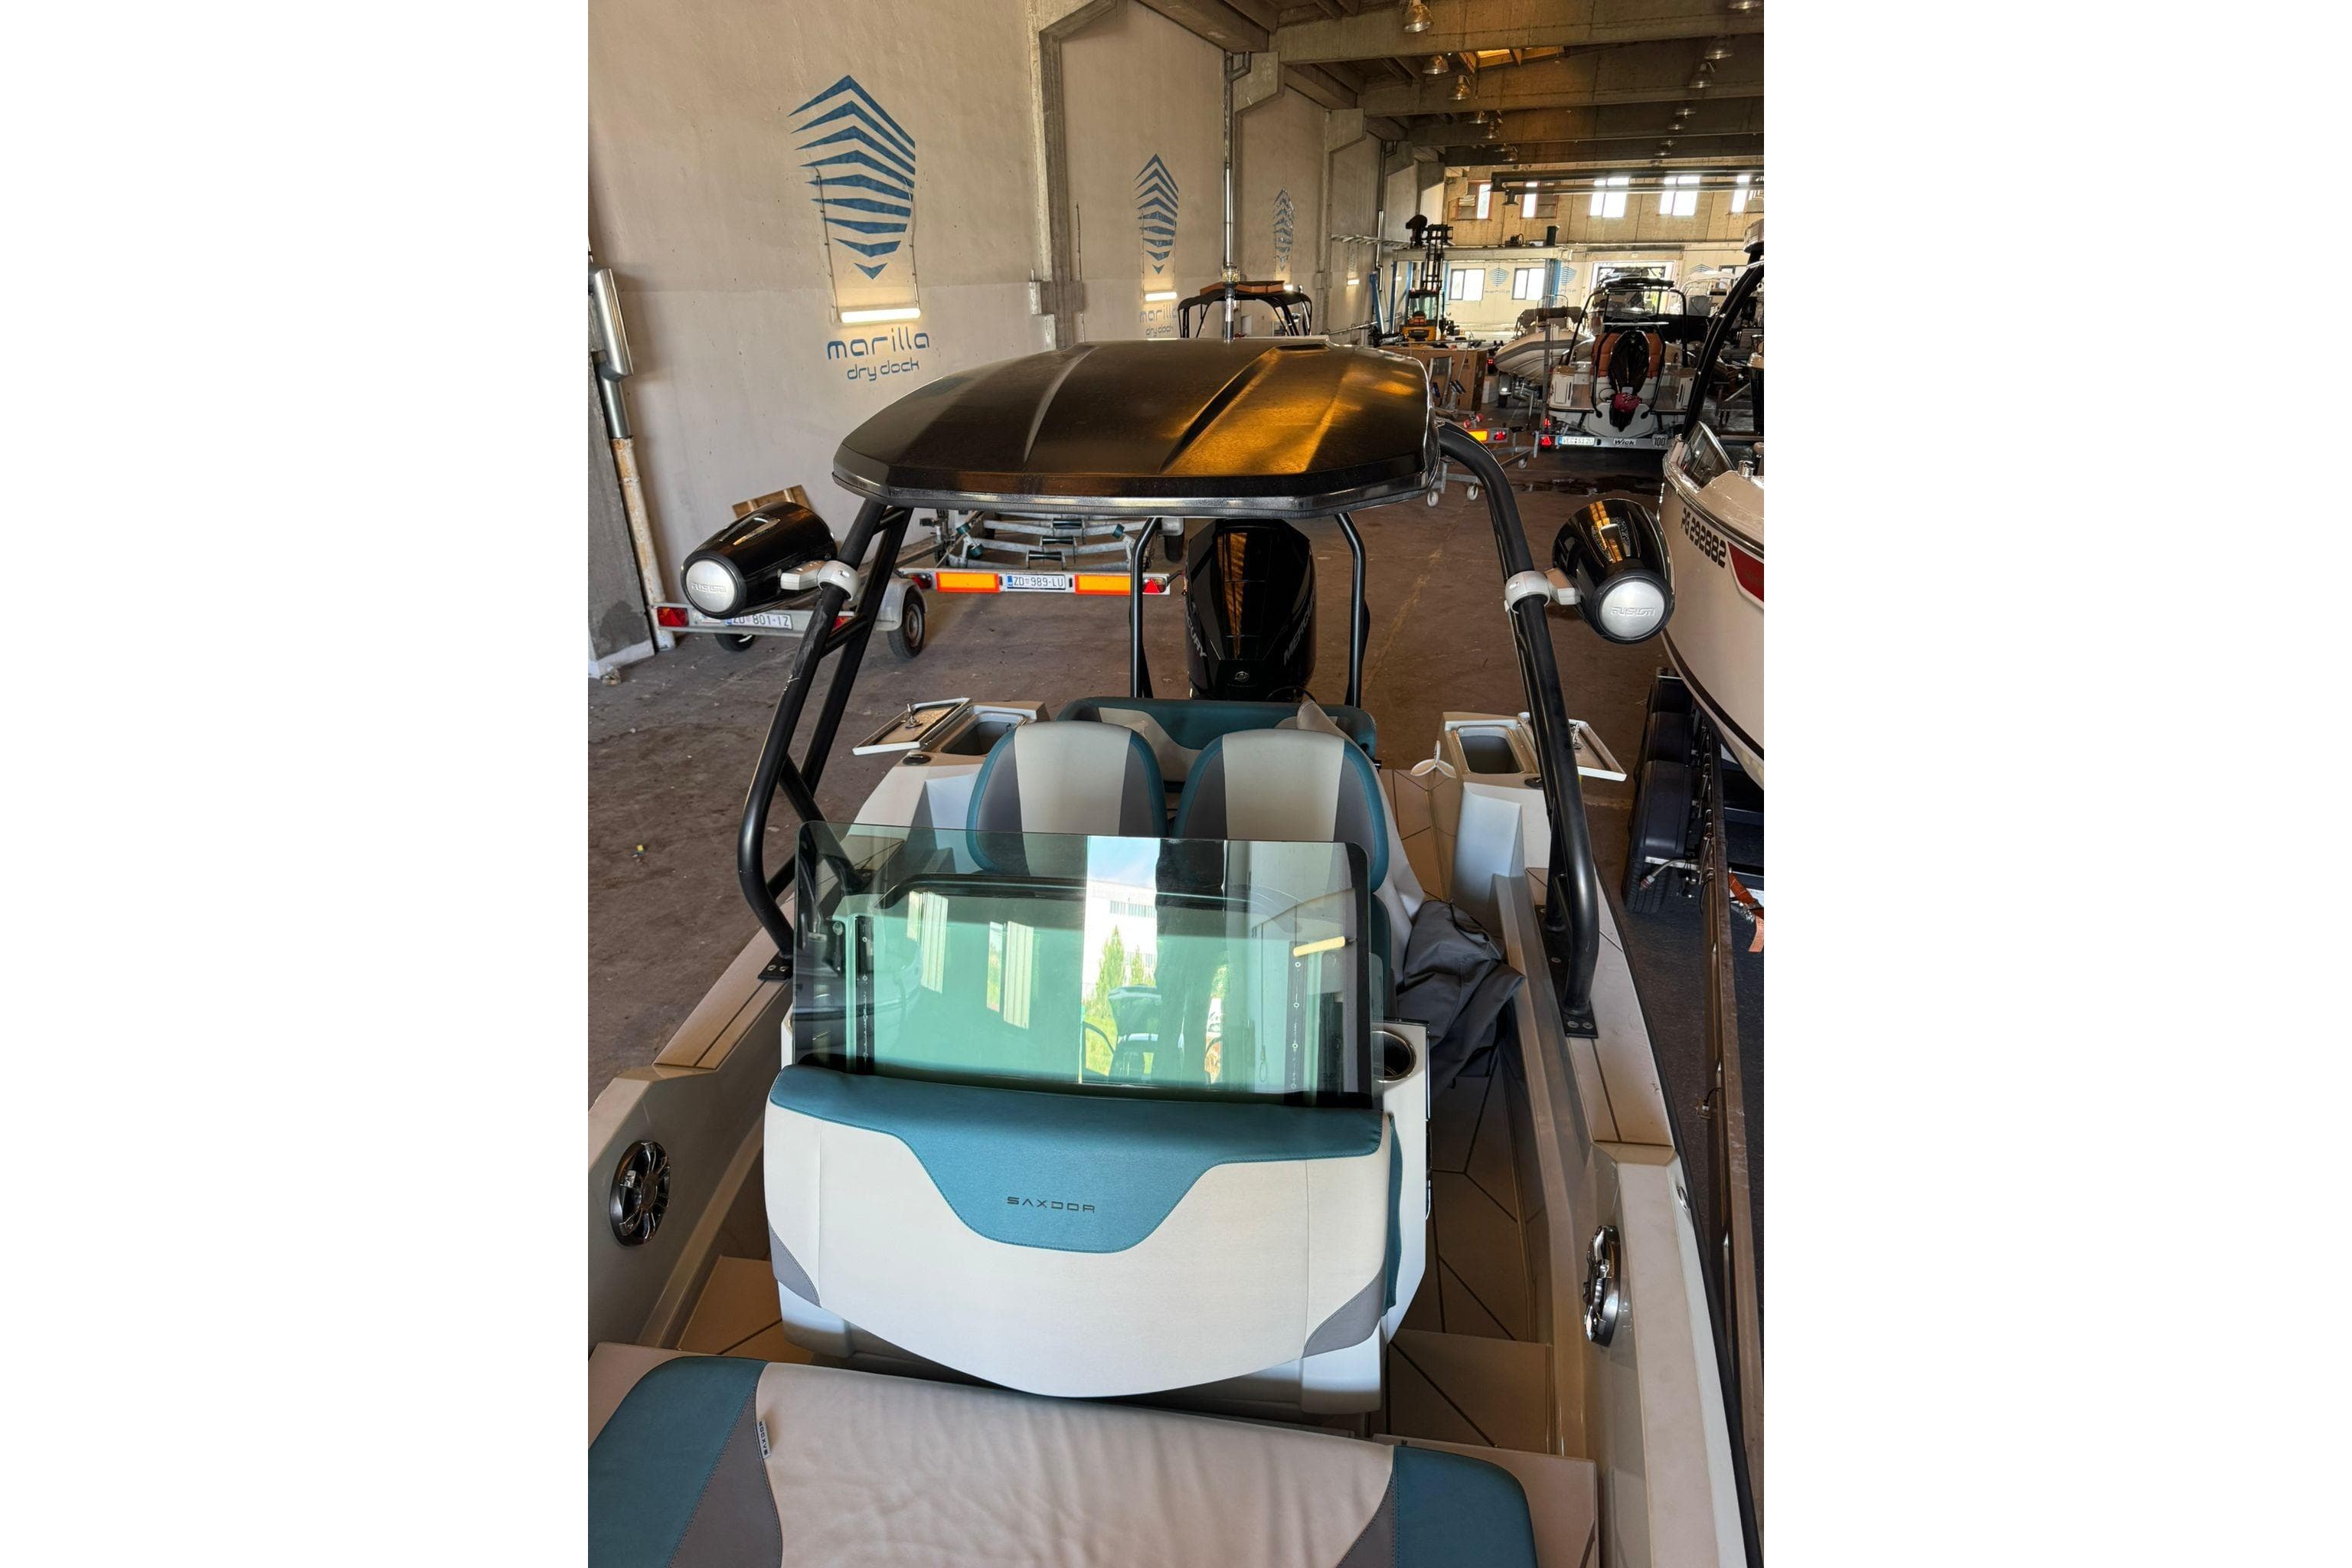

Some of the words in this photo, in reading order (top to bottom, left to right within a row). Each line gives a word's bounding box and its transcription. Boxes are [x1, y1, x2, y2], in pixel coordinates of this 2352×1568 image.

[827, 326, 930, 360] marilla
[847, 364, 877, 381] dry
[880, 357, 920, 375] dock
[1654, 437, 1665, 446] 100
[1690, 516, 1726, 569] 292882
[1014, 577, 1024, 586] ZD
[1031, 577, 1063, 587] 989-LU
[1610, 606, 1655, 617] FUSION
[753, 614, 790, 627] 801-IZ
[1007, 1196, 1096, 1214] SAXDOR
